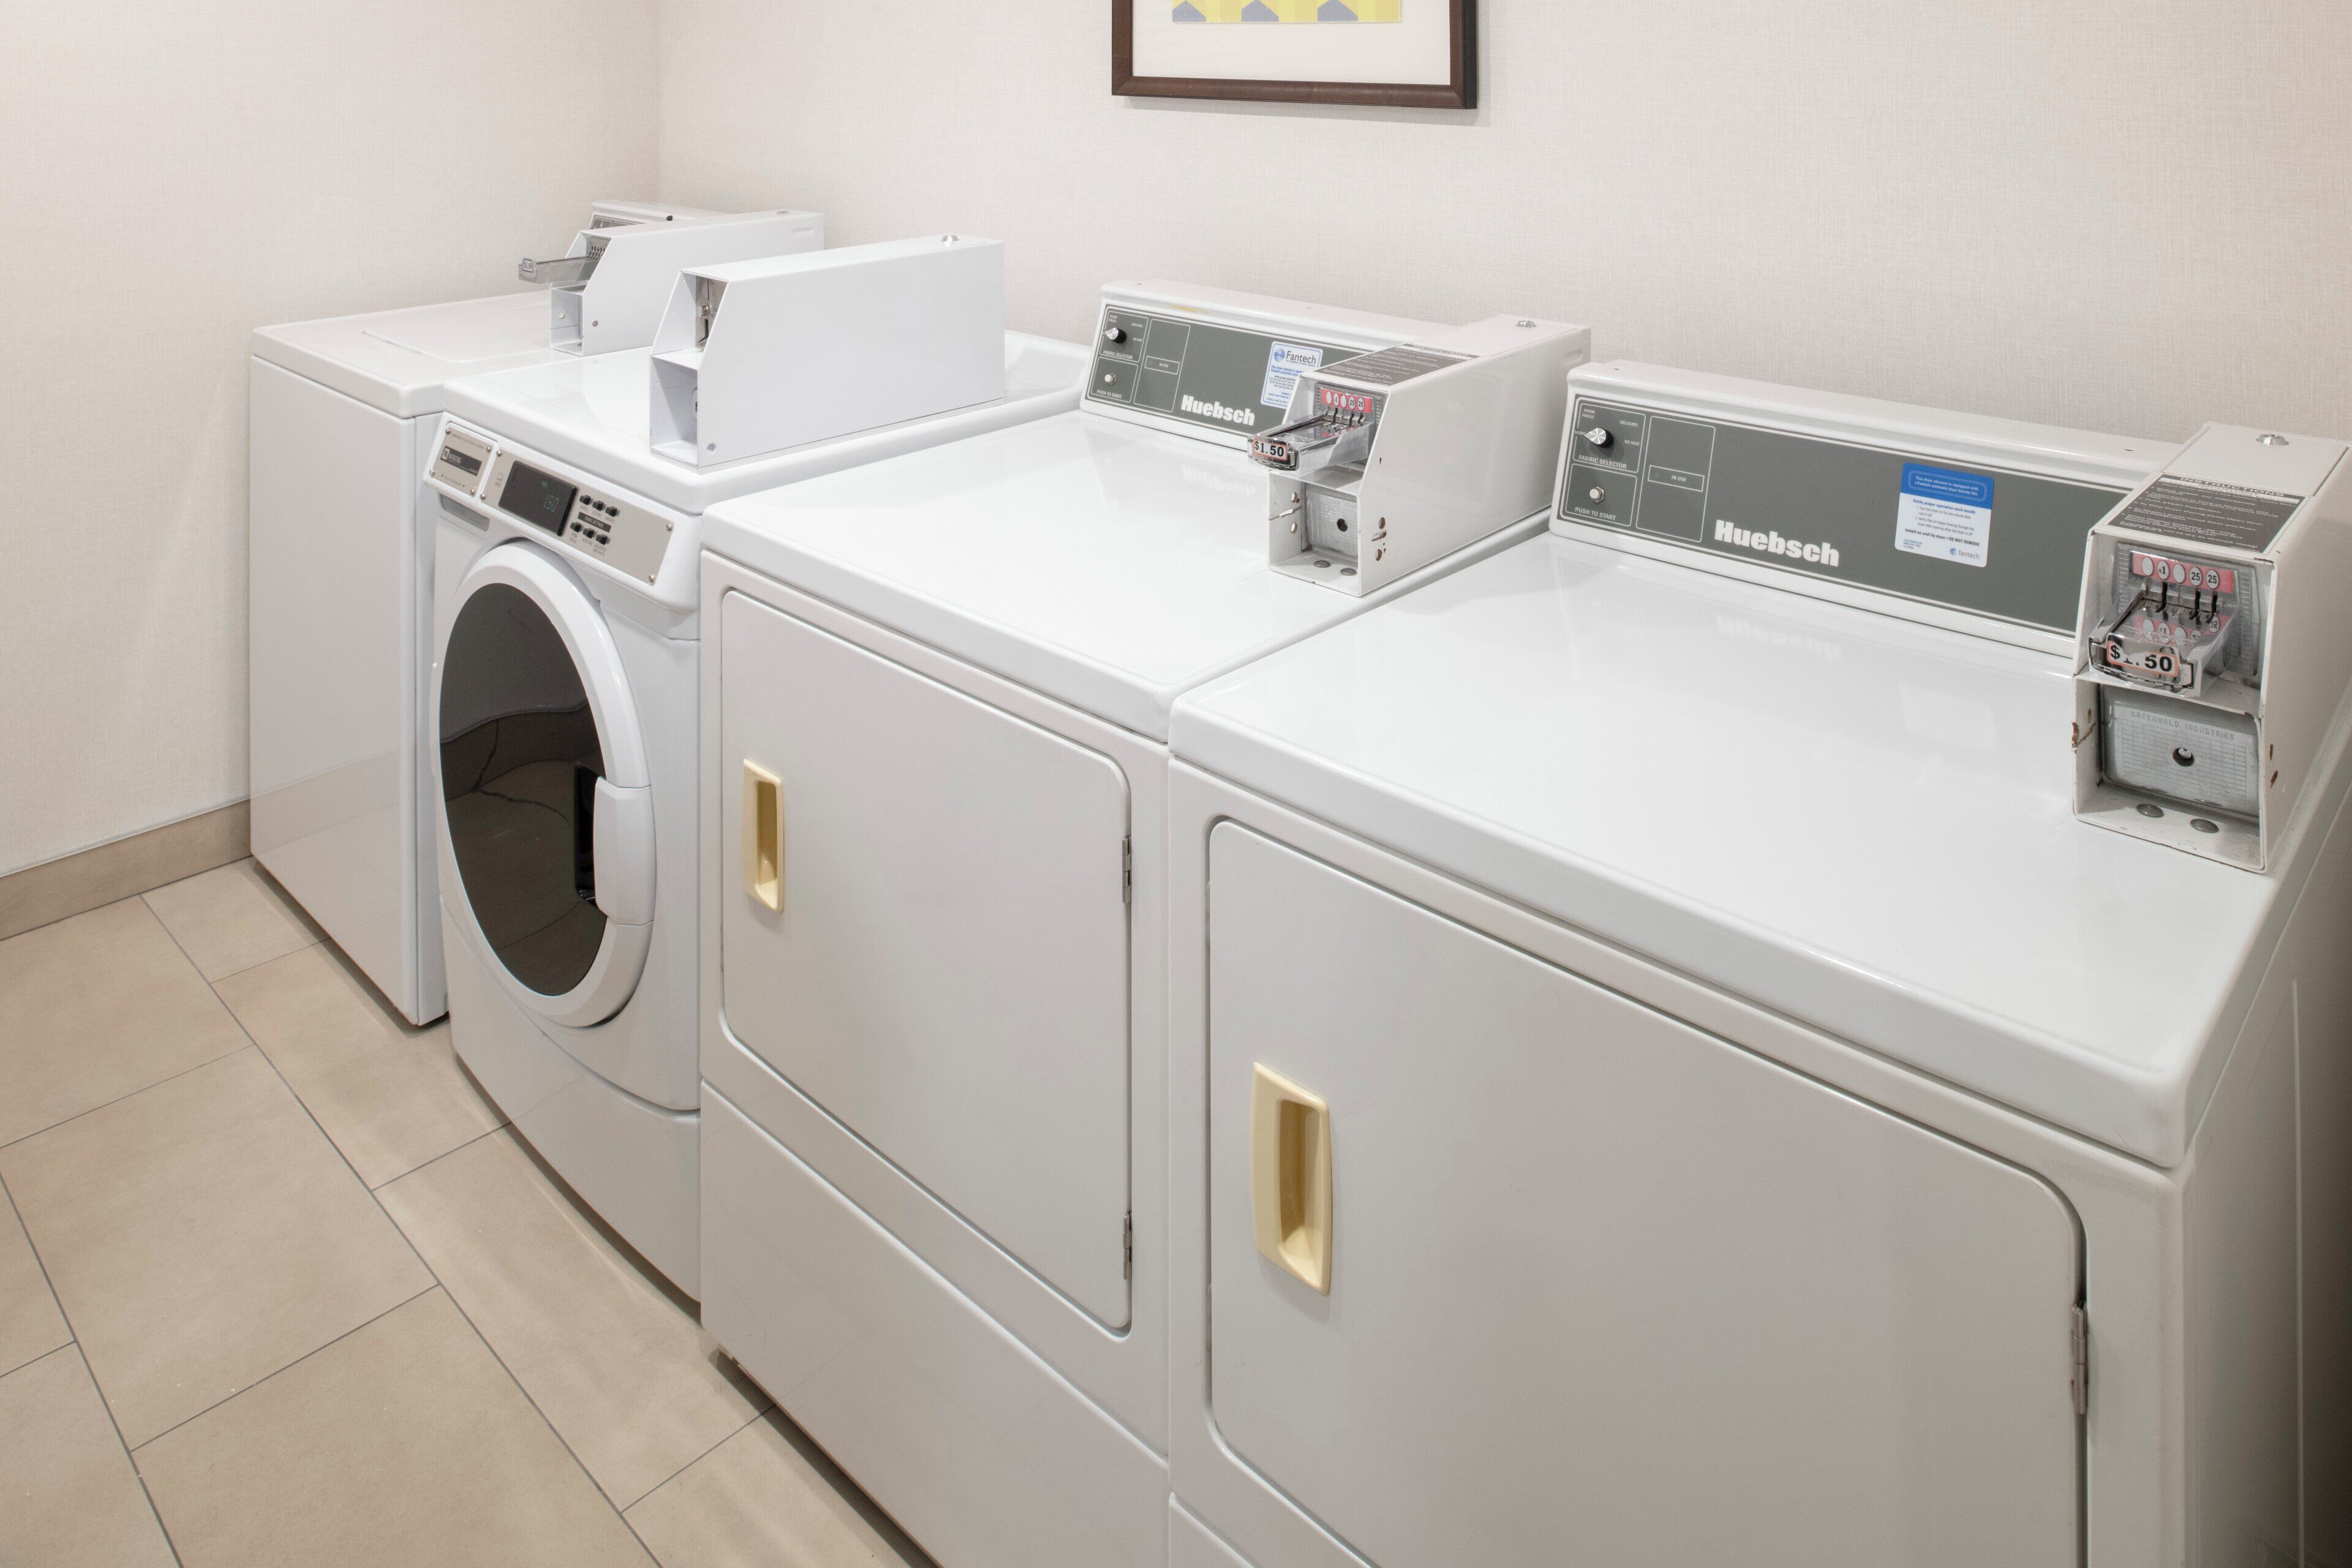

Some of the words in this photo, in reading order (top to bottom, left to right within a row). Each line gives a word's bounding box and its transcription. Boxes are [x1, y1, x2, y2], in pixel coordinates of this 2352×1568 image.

[1286, 350, 1316, 364] Fantech
[1181, 394, 1255, 426] Huebsch
[1254, 440, 1284, 457] $1.50
[1578, 454, 1598, 464] FABRIC
[1599, 459, 1627, 469] SELECTOR
[2180, 478, 2285, 496] INSTRUCTIONS
[1575, 507, 1589, 515] PUSH
[1599, 511, 1616, 521] START
[1714, 519, 1839, 567] Huebsch
[1958, 549, 1980, 560] fantech
[2191, 572, 2200, 581] 25
[2207, 575, 2217, 584] 25
[2131, 710, 2179, 728] GREENWALD
[2185, 723, 2234, 741] INDUSTRIES
